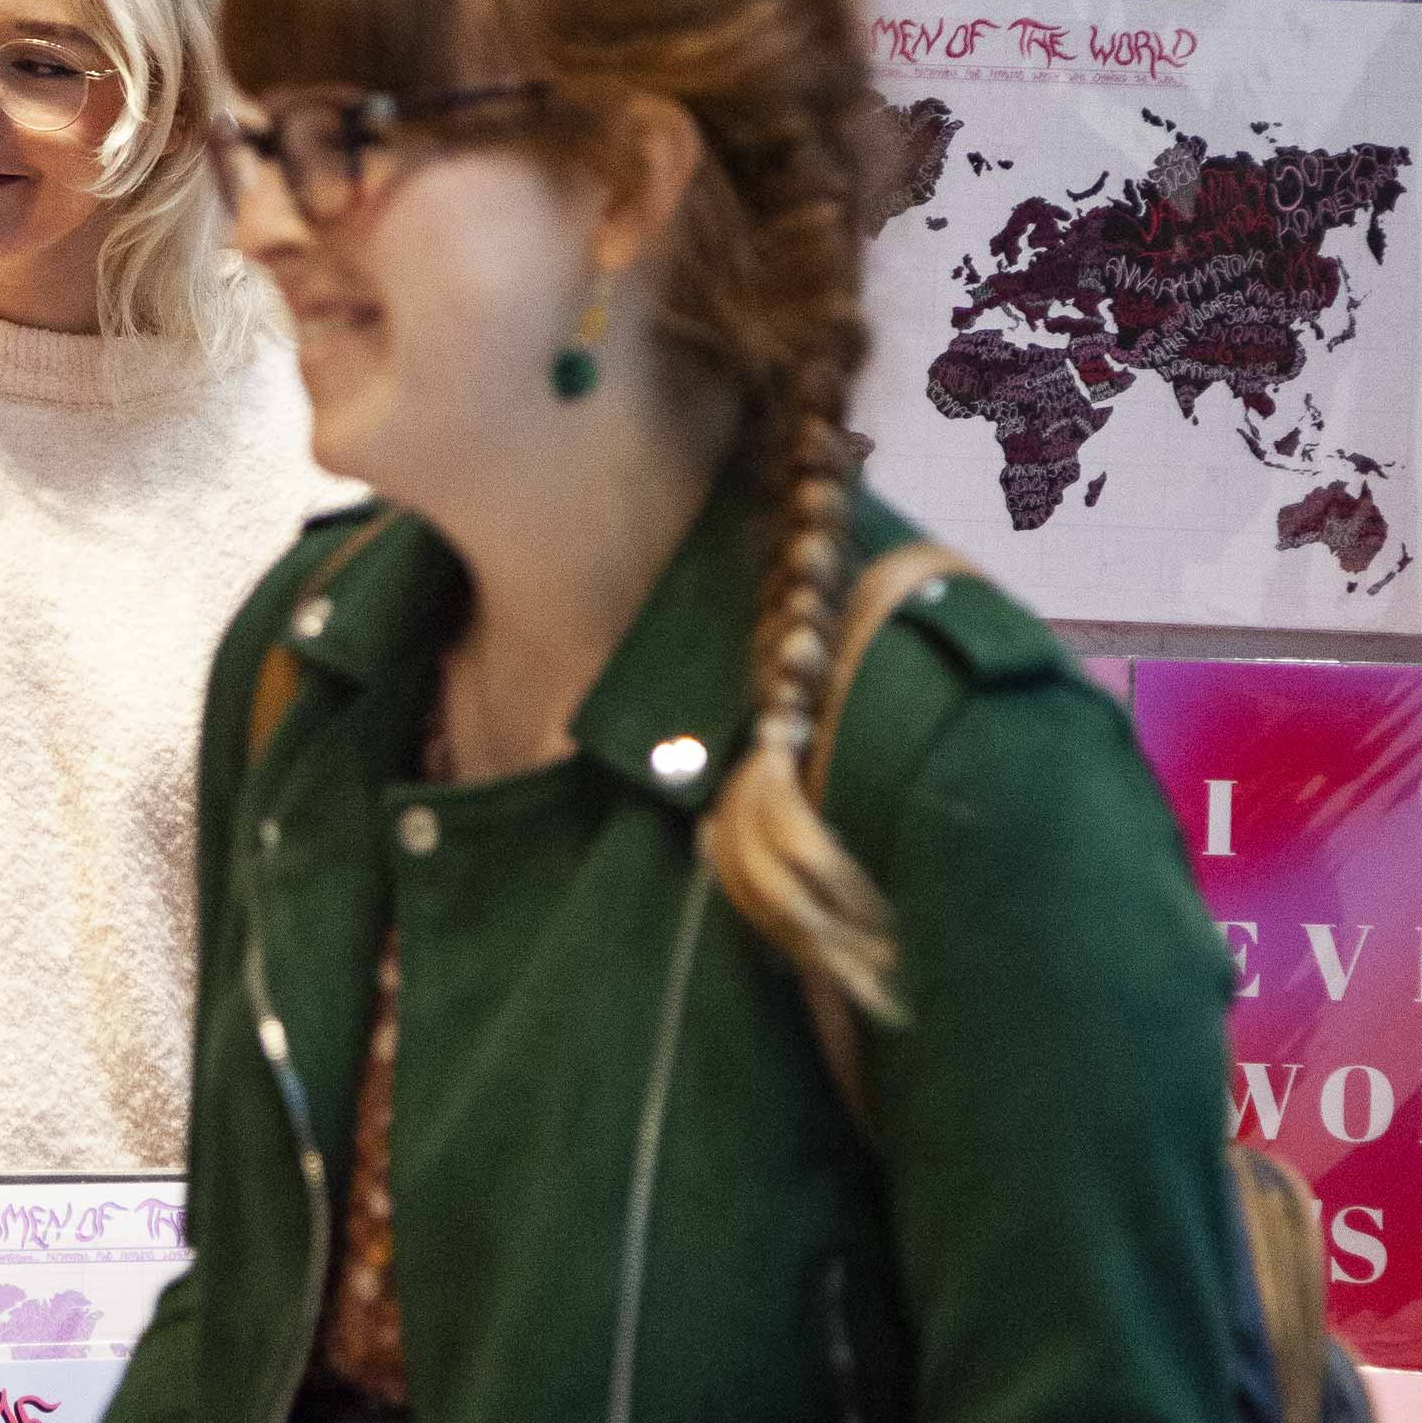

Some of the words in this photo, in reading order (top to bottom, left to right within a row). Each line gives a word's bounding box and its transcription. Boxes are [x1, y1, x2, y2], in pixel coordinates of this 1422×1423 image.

[874, 18, 943, 63] MEN
[946, 18, 1002, 59] OF
[1008, 17, 1077, 68] THE
[1089, 25, 1198, 80] WORLD
[1203, 779, 1238, 856] I
[75, 1201, 129, 1243] OF
